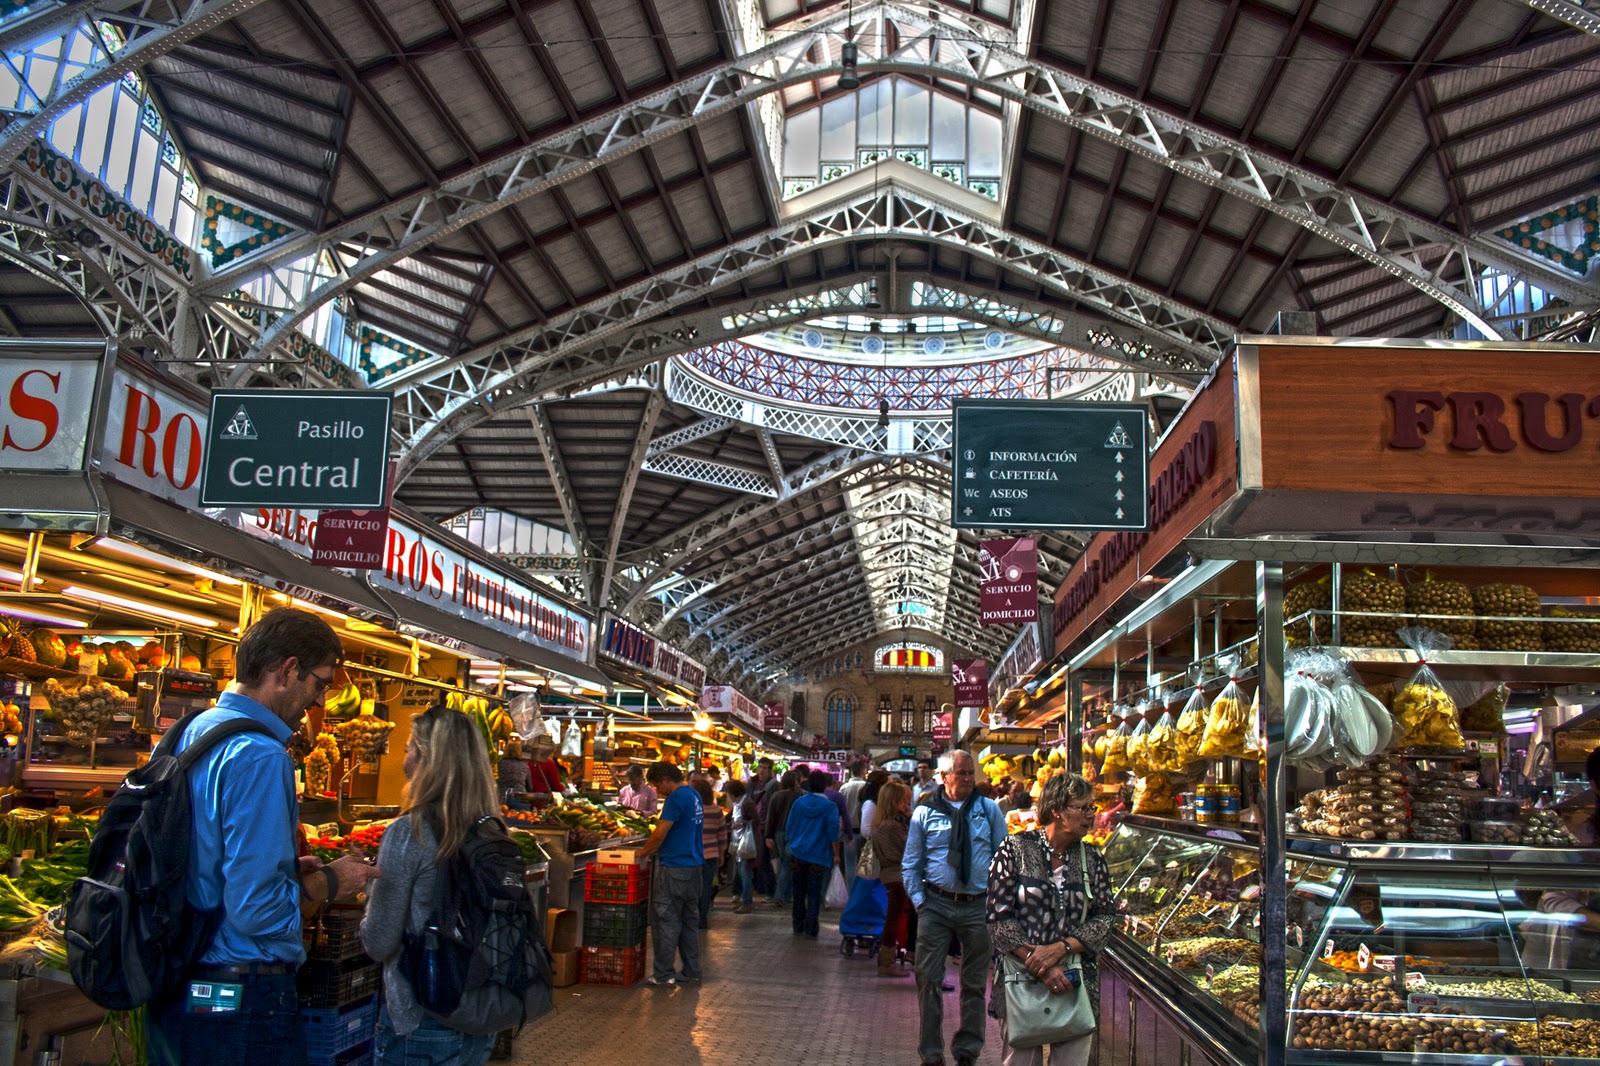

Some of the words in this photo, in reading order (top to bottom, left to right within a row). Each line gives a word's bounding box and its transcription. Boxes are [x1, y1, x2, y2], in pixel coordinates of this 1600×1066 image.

[297, 420, 365, 440] Pasillo
[989, 450, 1077, 463] INFORMACIÓN
[228, 456, 359, 489] Central
[989, 469, 1059, 481] CAFETERÍA
[989, 488, 1028, 499] ASEOS
[989, 507, 1012, 518] ATS
[323, 518, 381, 531] SERVICIO
[345, 536, 354, 546] A
[315, 549, 380, 564] DOMICILIO
[383, 526, 445, 600] ROS
[451, 562, 516, 626] FRUITES
[528, 598, 586, 654] VERDURES
[985, 584, 1032, 594] SERVICIO
[1005, 598, 1012, 606] A
[982, 609, 1035, 620] DOMICILIO
